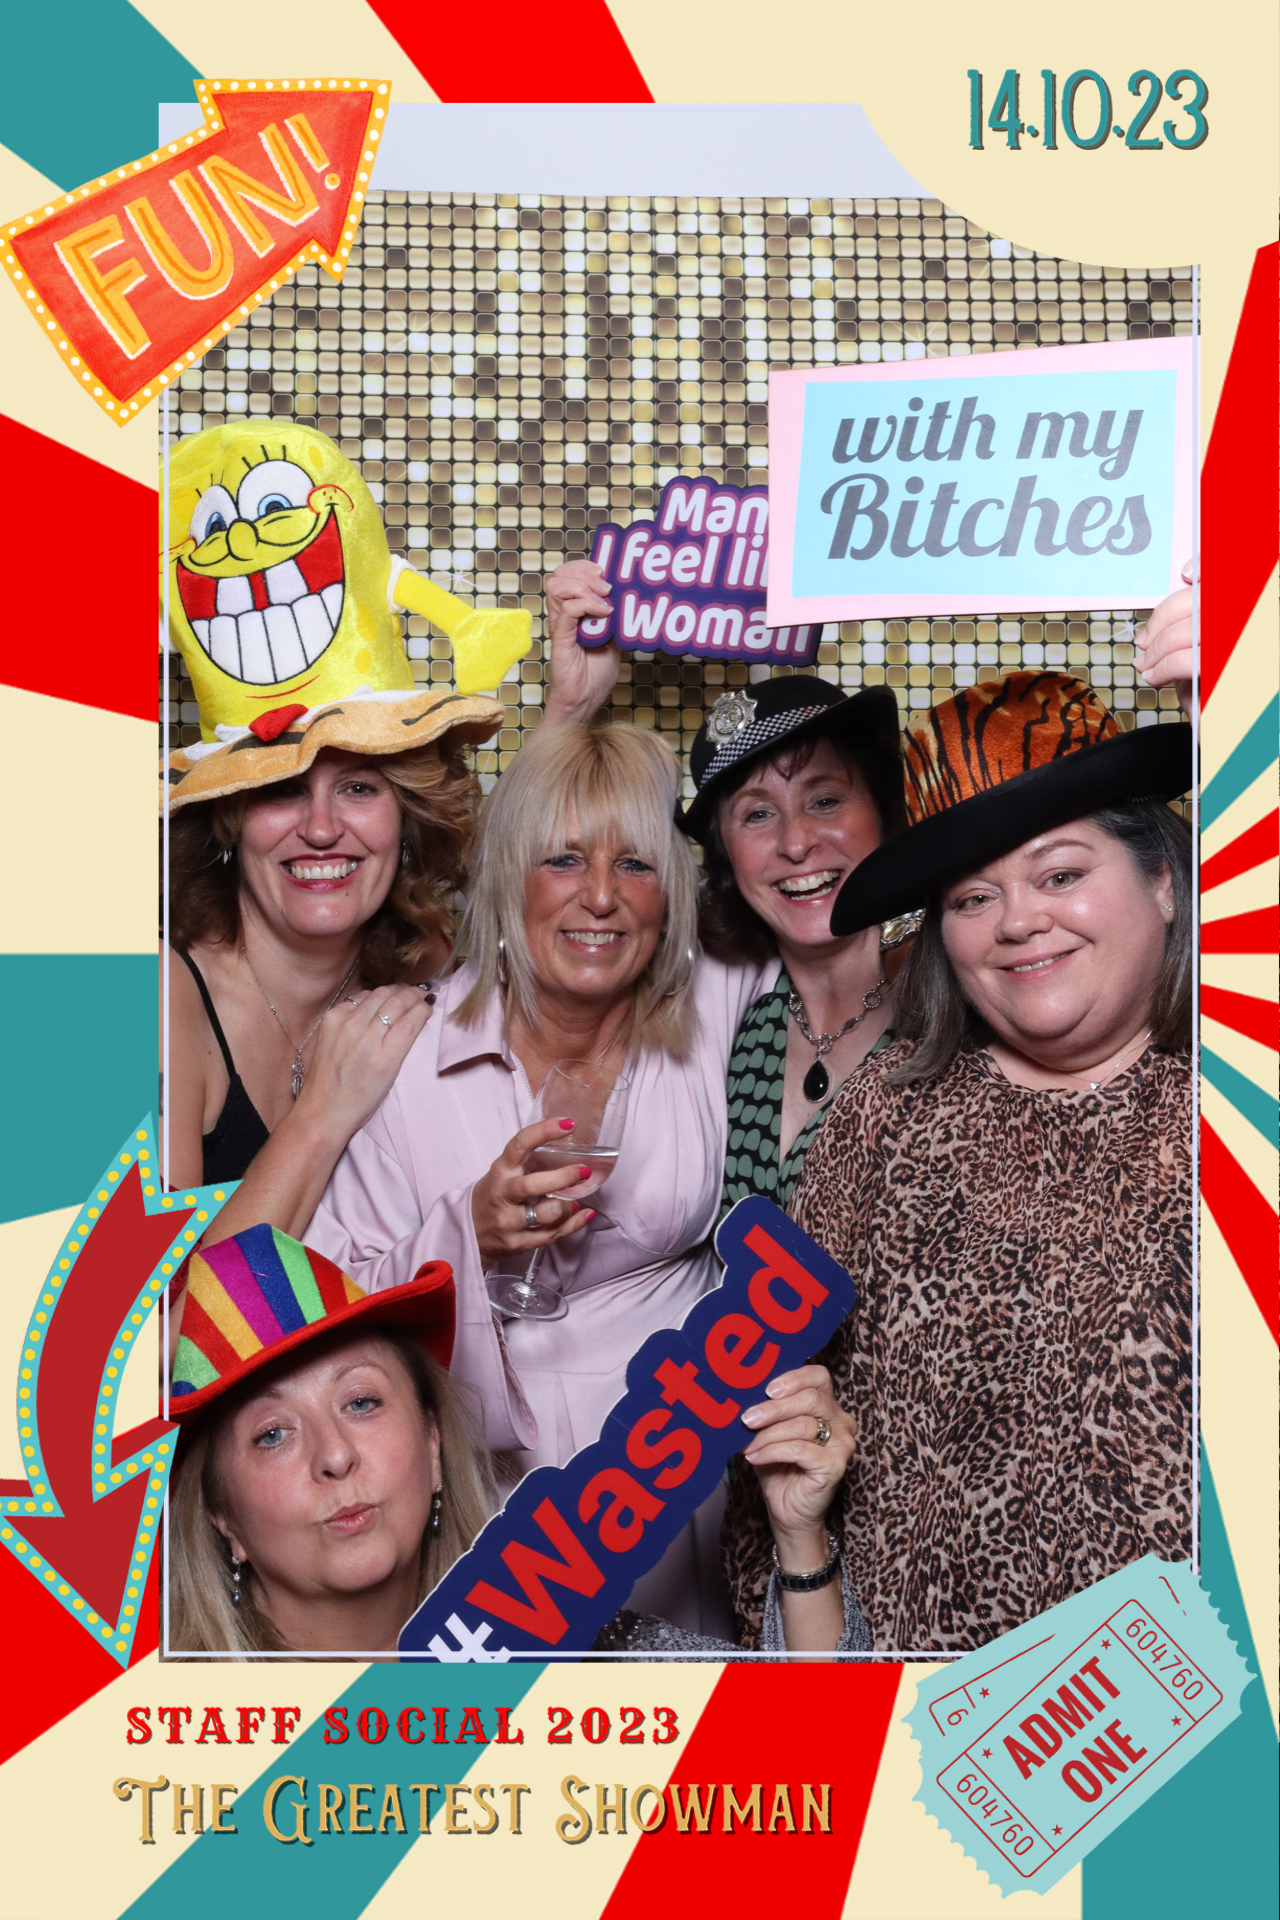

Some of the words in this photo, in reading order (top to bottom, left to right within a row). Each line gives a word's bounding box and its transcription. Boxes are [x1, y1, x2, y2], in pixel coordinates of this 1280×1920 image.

[831, 395, 997, 464] with
[1015, 409, 1144, 480] my
[662, 487, 768, 534] Man
[820, 473, 1152, 561] Bitches
[620, 531, 720, 584] feel
[727, 534, 768, 588] li
[623, 594, 810, 653] Woman
